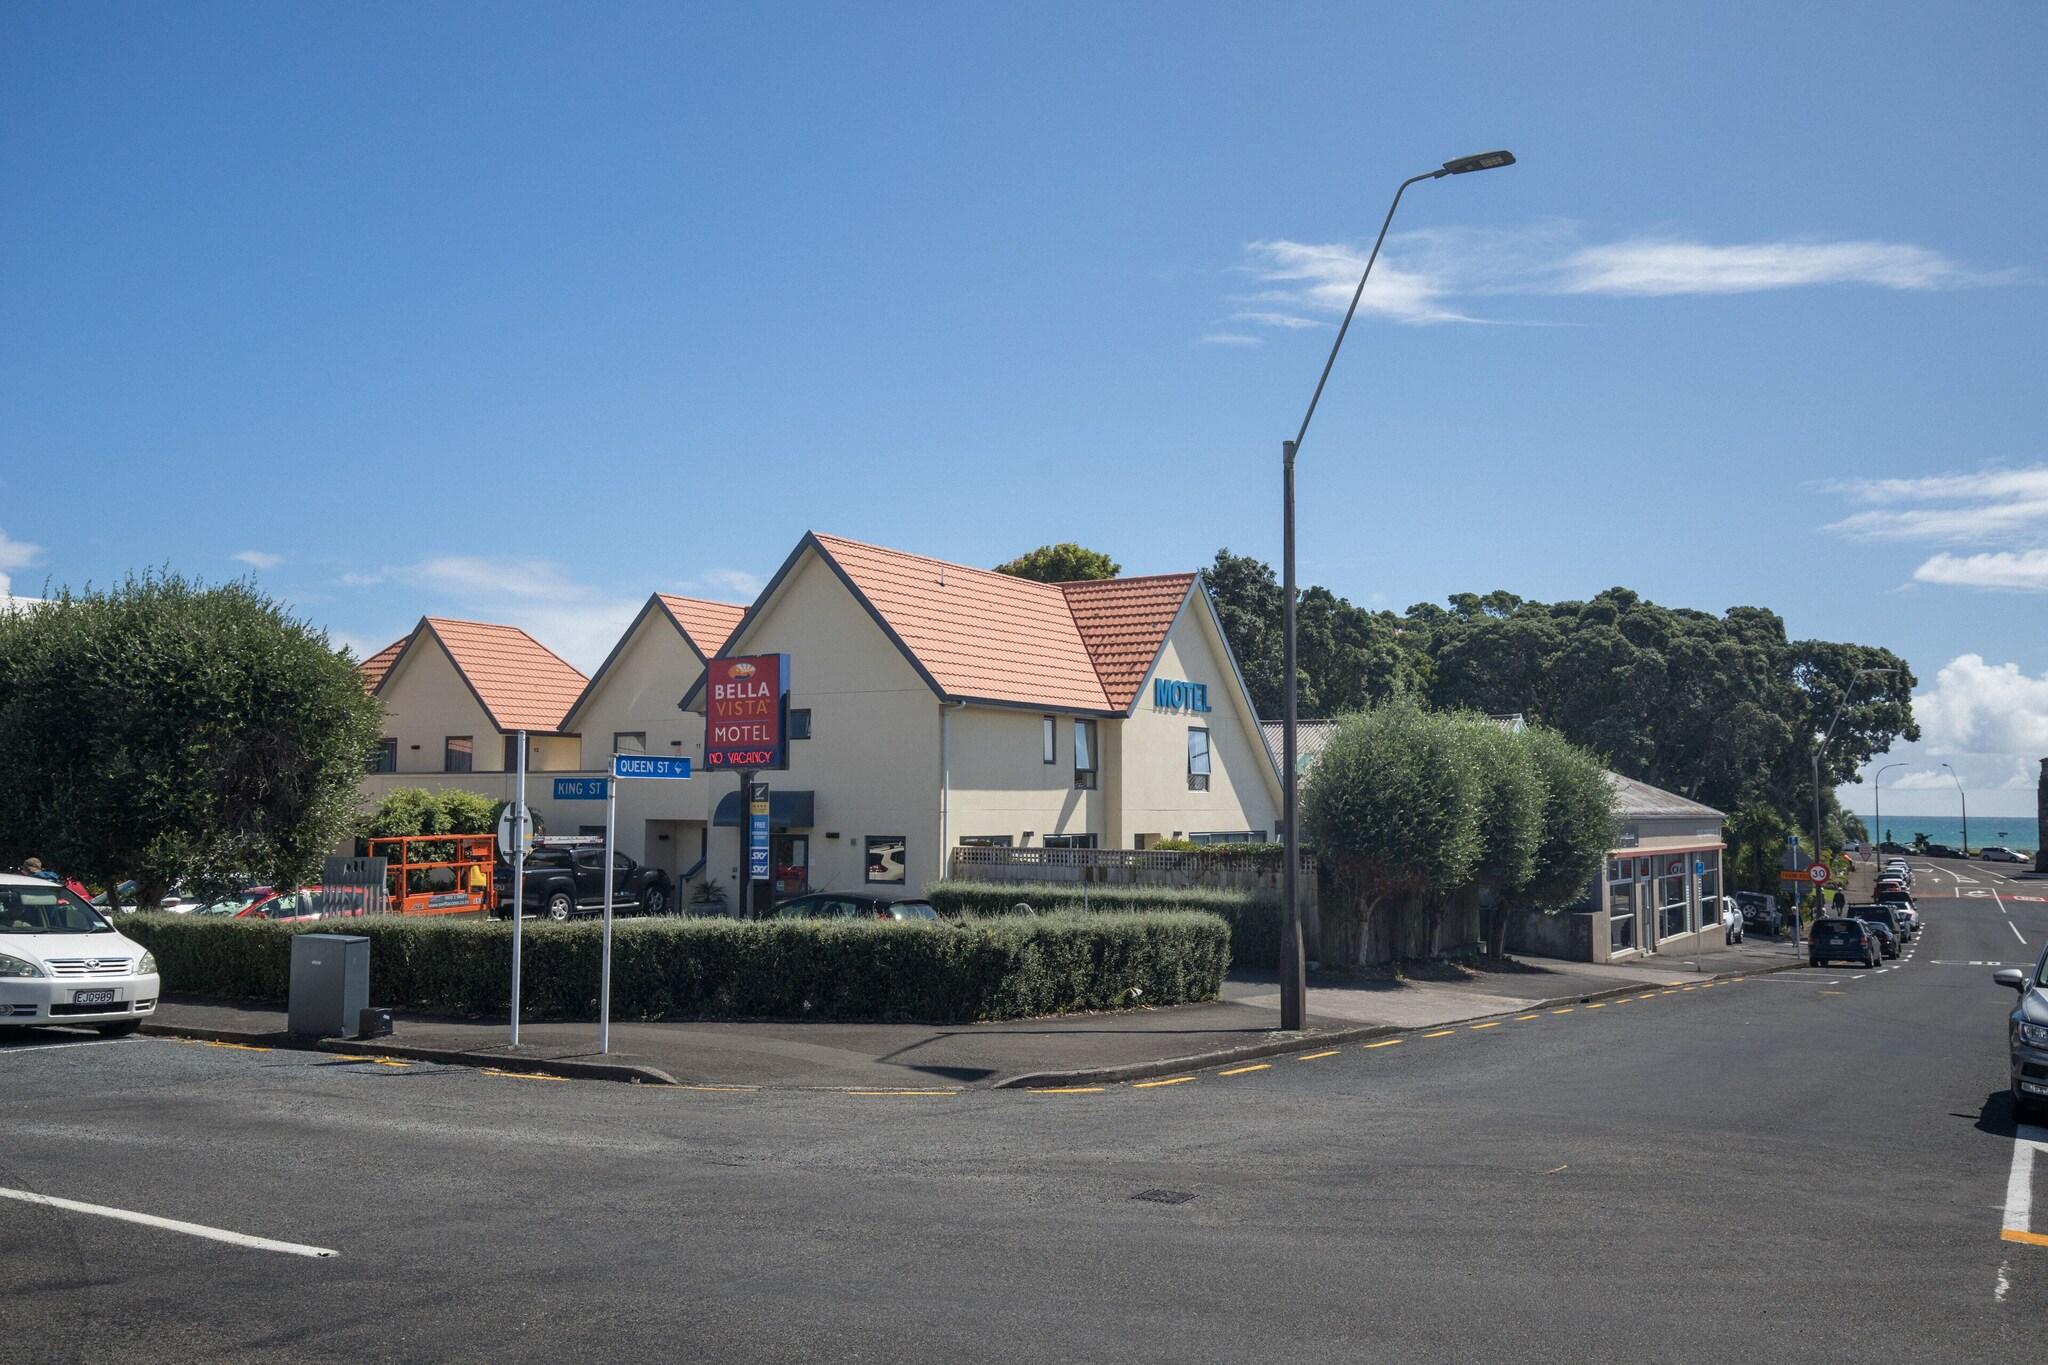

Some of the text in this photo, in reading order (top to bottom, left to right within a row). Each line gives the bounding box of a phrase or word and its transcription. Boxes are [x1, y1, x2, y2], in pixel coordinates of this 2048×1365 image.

[715, 682, 770, 699] BELLA
[1154, 678, 1212, 713] MOTEL
[716, 700, 768, 716] VISTA
[715, 725, 770, 742] MOTEL
[709, 751, 772, 764] NO VACANCY
[620, 759, 670, 774] QUEEN ST
[558, 782, 602, 795] KING ST
[1812, 869, 1826, 878] 30
